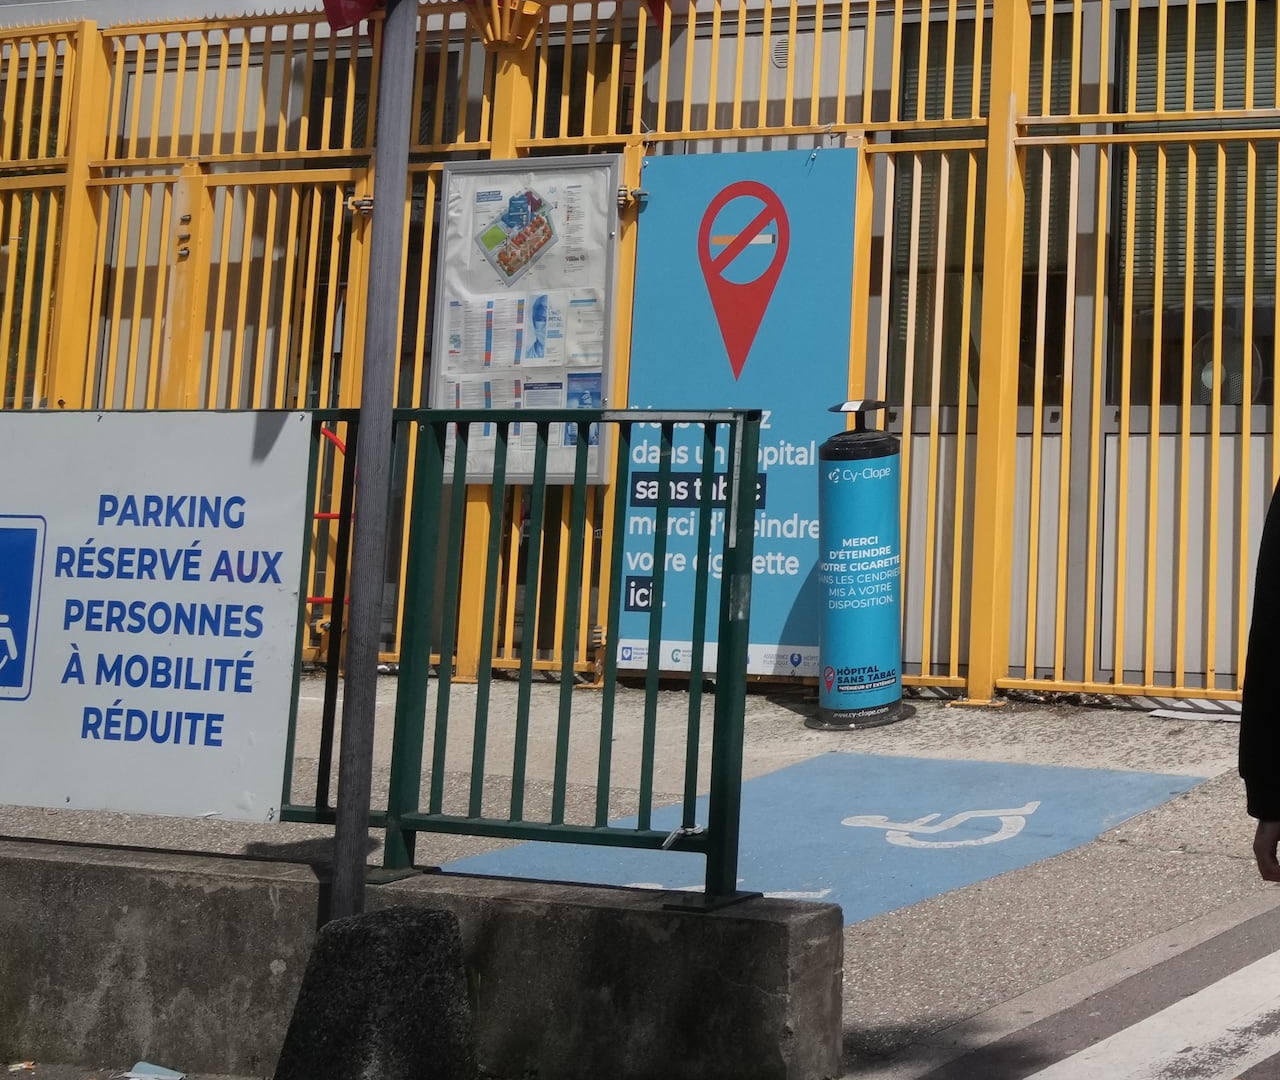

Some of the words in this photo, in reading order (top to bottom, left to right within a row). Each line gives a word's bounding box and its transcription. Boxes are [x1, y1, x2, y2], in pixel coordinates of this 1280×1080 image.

[842, 467, 891, 483] Cy-Clope
[97, 494, 247, 529] PARKING
[842, 535, 879, 548] MERCI
[829, 545, 892, 560] D'ÉTEINDRE
[54, 537, 202, 582] RÉSERVÉ
[209, 550, 284, 584] AUX
[836, 575, 854, 585] LES
[829, 587, 846, 597] MIS
[859, 582, 892, 596] VOTRE
[63, 599, 264, 638] PERSONNES
[61, 643, 85, 685] À
[95, 650, 255, 693] MOBILITÉ
[837, 665, 879, 676] HÔPITAL
[837, 675, 864, 683] SANS
[868, 669, 896, 681] TABAC
[81, 698, 225, 747] RÉDUITE
